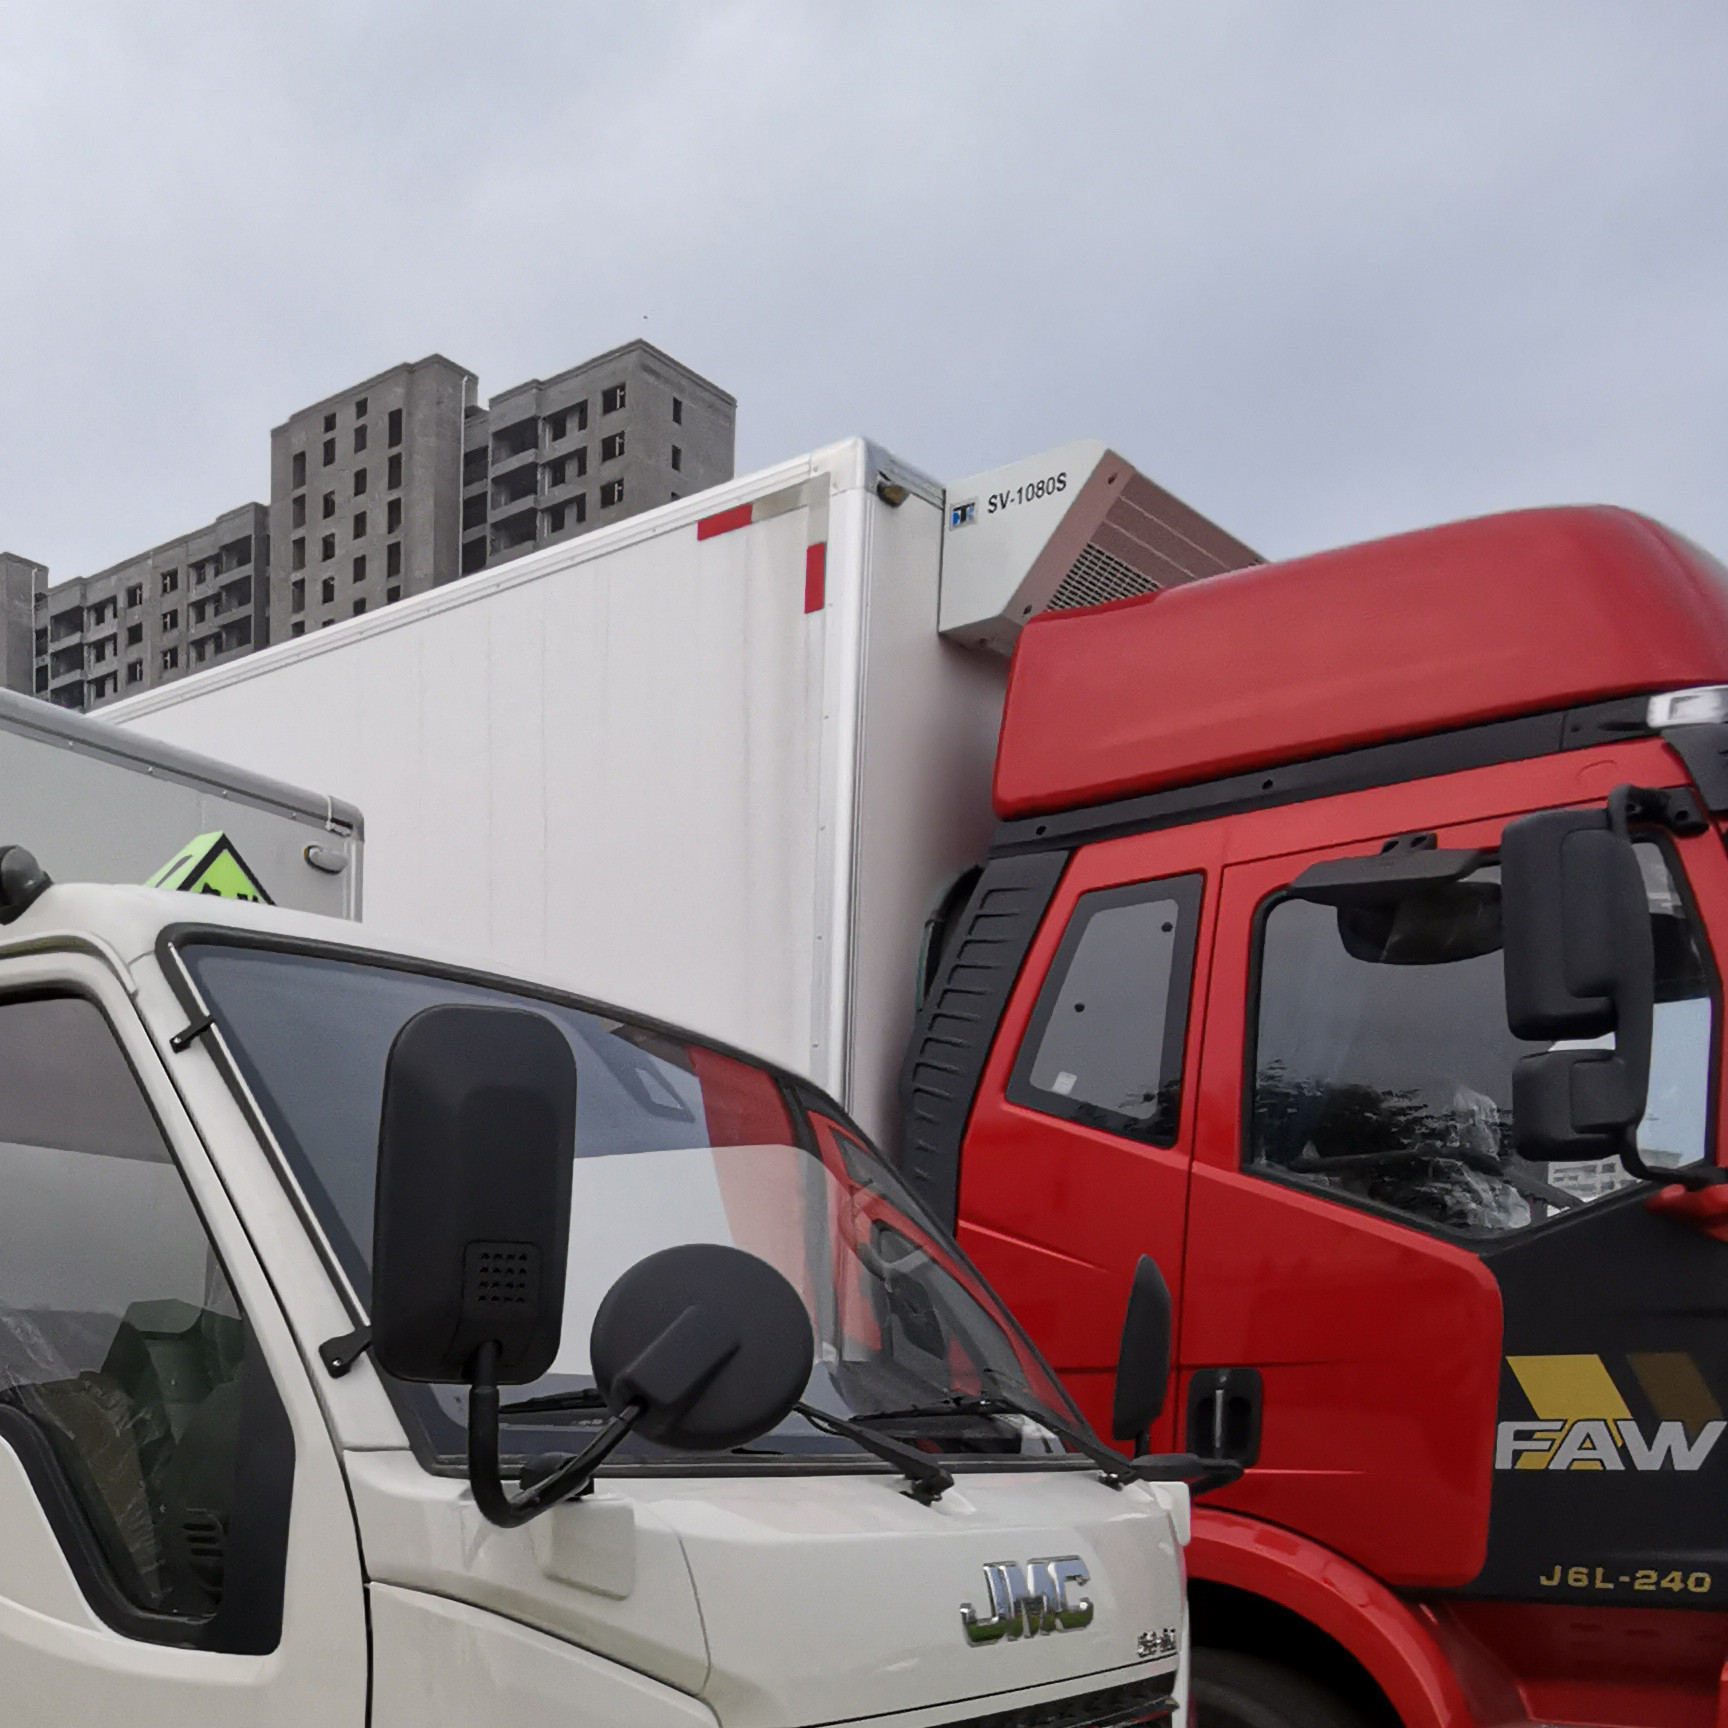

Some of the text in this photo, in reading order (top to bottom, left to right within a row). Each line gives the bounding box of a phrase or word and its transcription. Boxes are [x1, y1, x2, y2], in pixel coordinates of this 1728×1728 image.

[987, 471, 1068, 514] SV-1080S
[1494, 1419, 1728, 1472] FAW
[960, 1554, 1095, 1649] JMC
[1539, 1564, 1713, 1593] J6L-240
